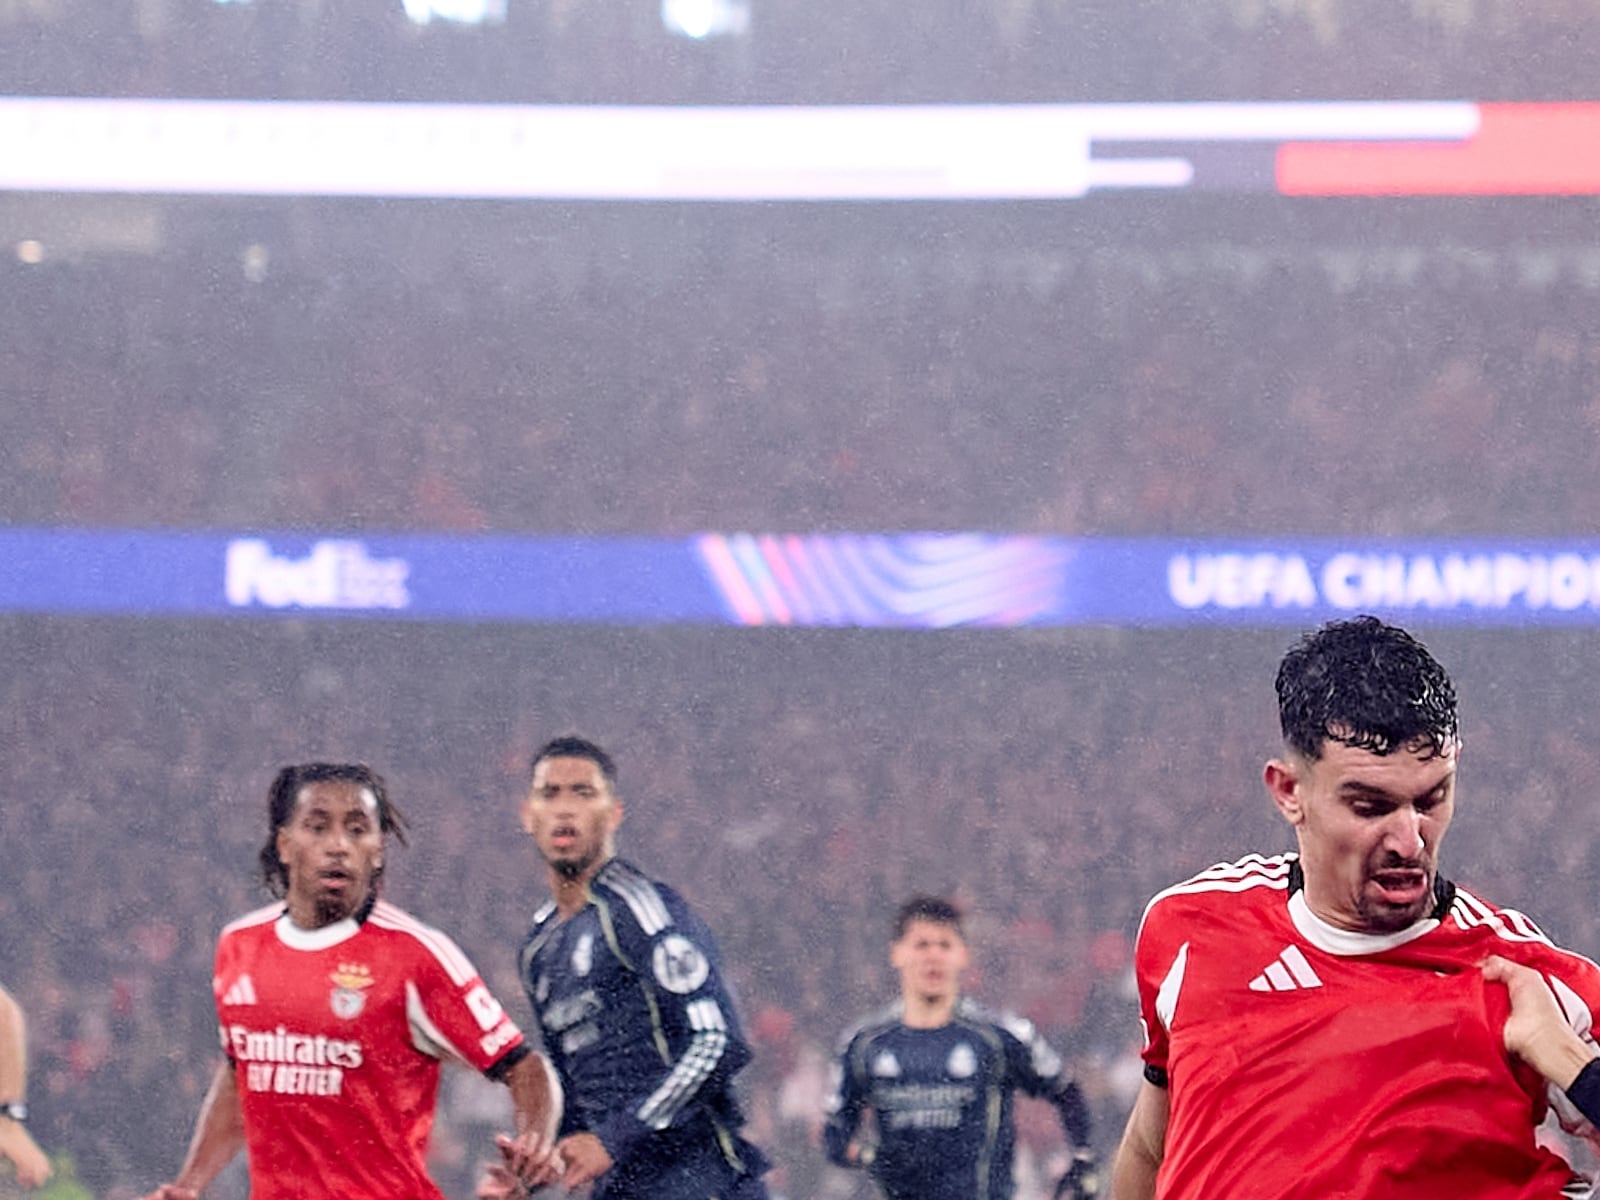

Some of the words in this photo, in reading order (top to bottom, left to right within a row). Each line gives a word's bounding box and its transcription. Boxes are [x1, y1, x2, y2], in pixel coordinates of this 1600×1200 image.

[1168, 552, 1316, 608] UEFA
[230, 1024, 364, 1069] Emirates
[274, 1064, 343, 1096] BETTER
